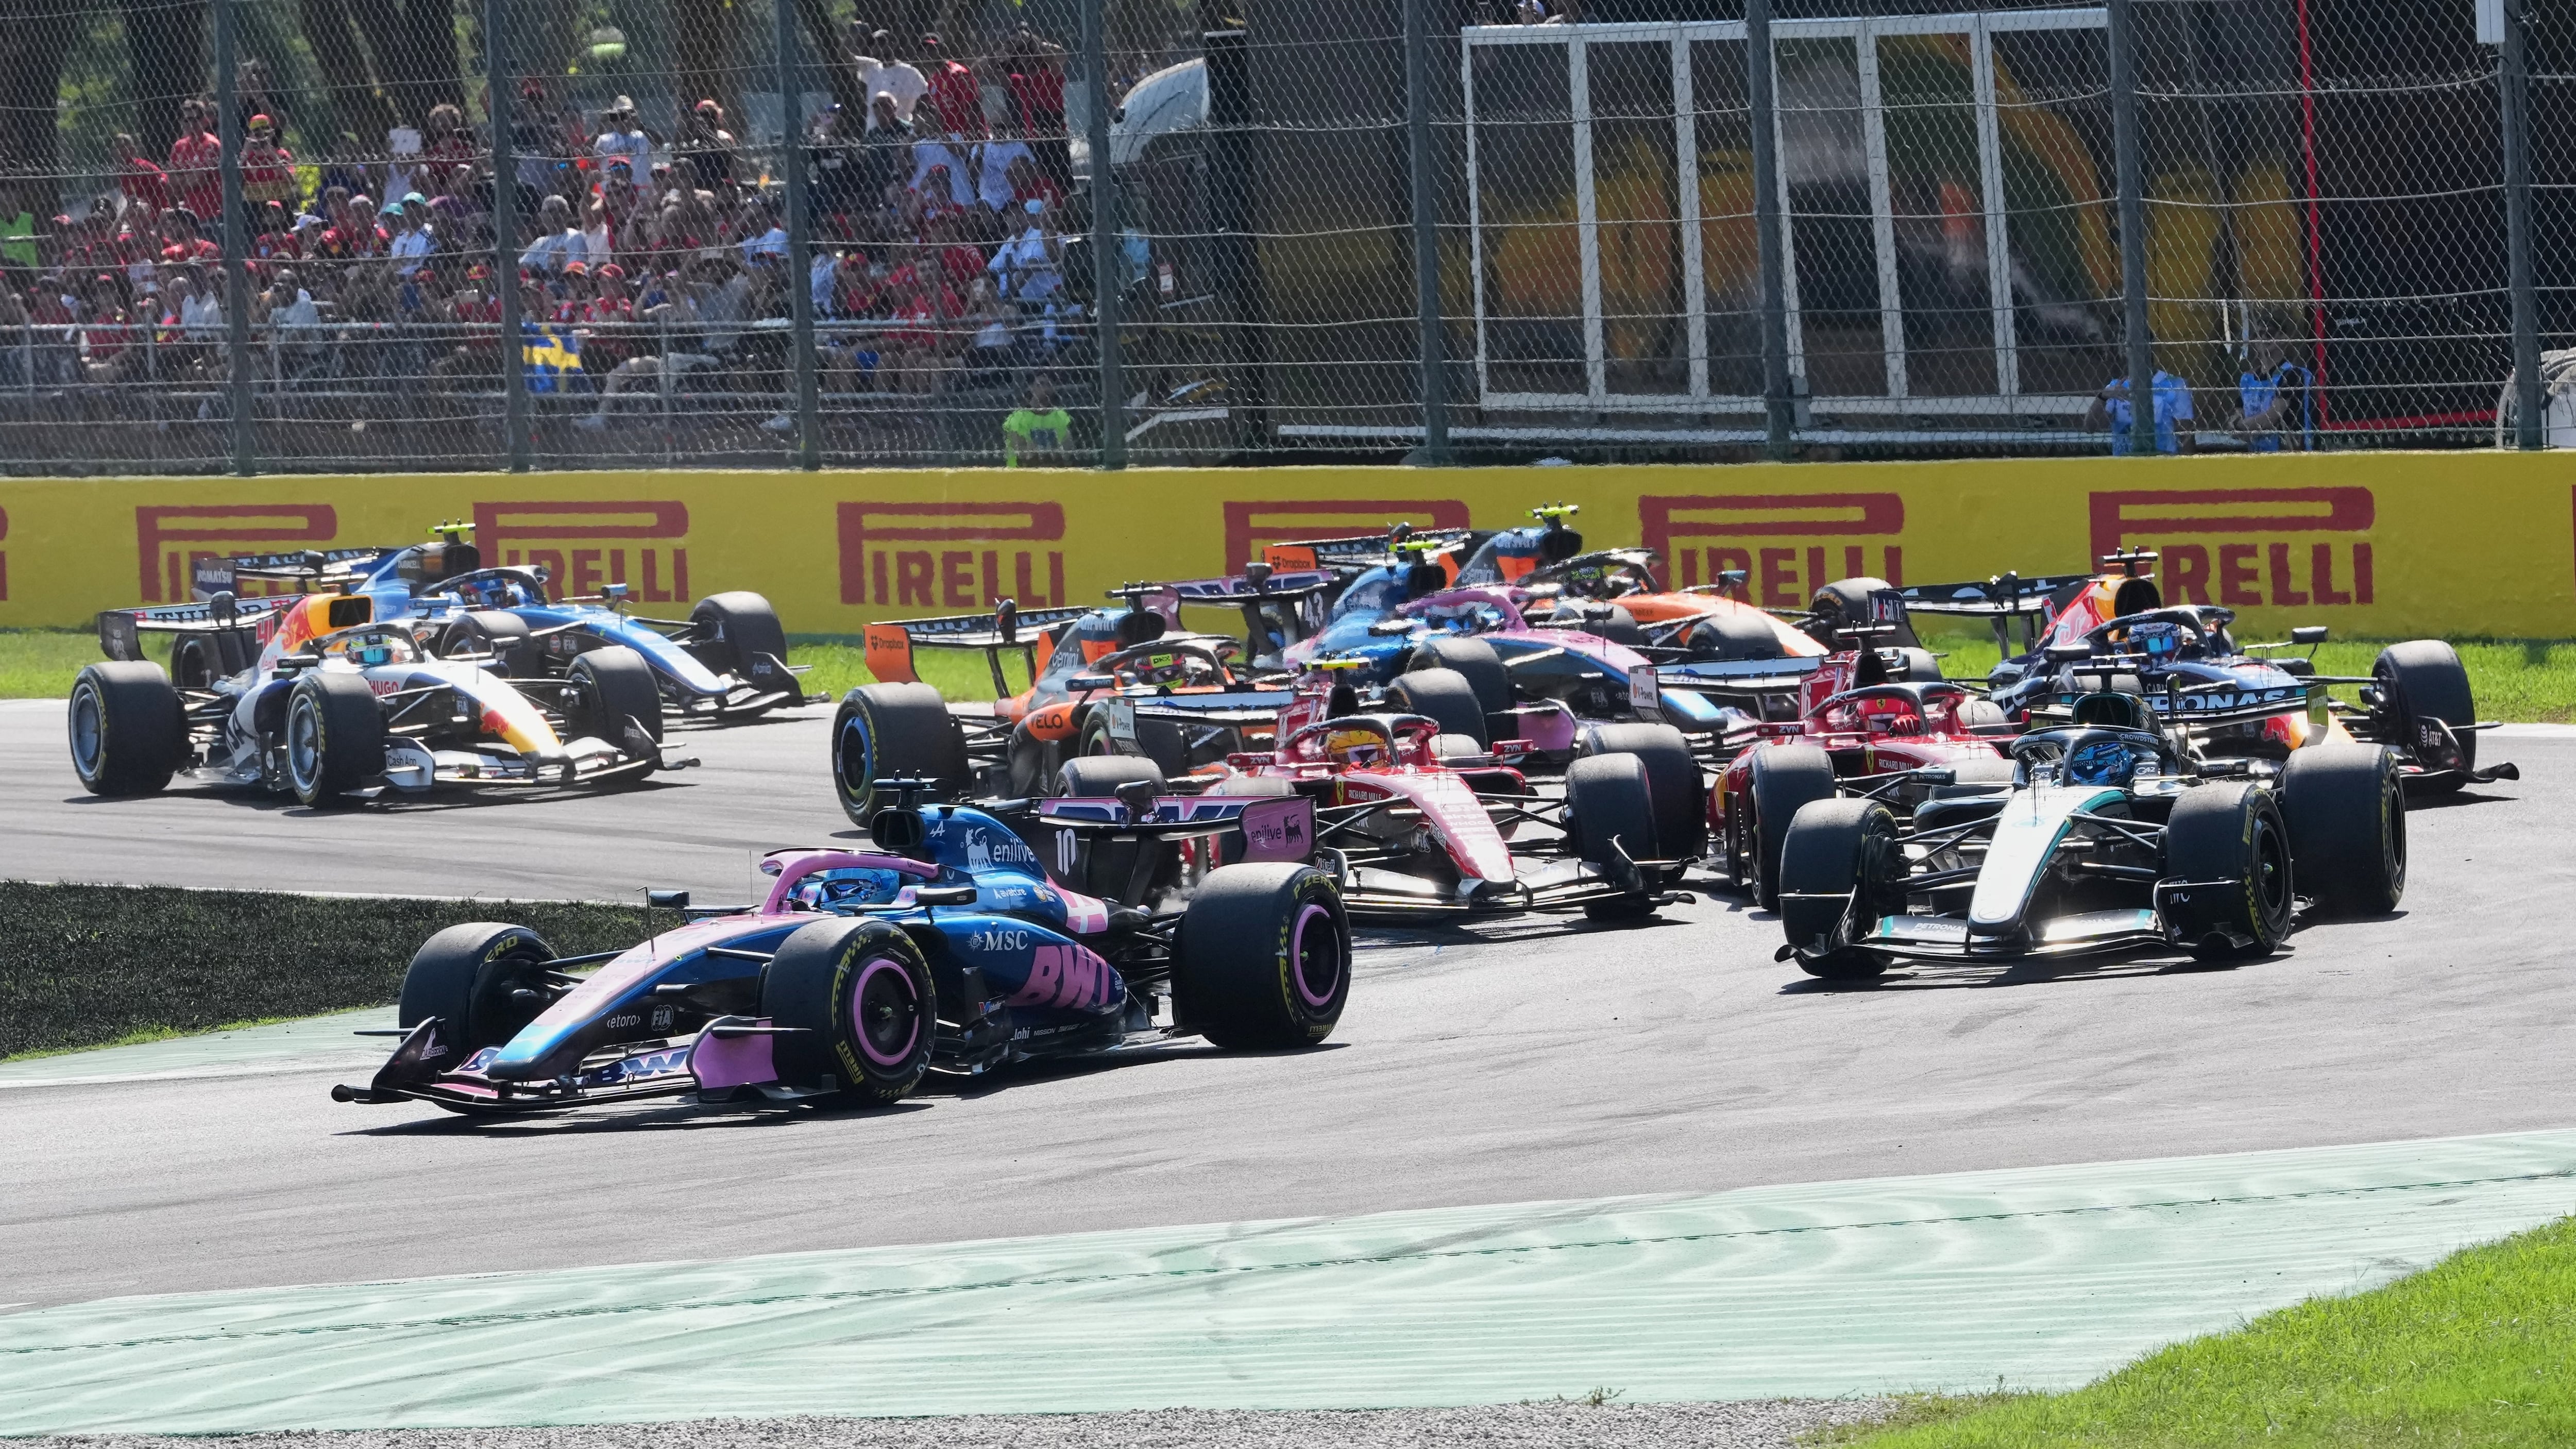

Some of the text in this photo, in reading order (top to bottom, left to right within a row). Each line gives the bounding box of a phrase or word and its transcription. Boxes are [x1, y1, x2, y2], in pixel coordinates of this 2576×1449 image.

[2089, 486, 2375, 605] PRELLI
[837, 501, 1065, 608] PIRELLI
[1283, 558, 1311, 568] Dropbox
[196, 568, 232, 584] KOMATSU
[1872, 597, 1895, 621] Mobil
[879, 637, 905, 651] Dropbox
[1053, 647, 1079, 668] Gemini
[368, 681, 399, 696] HUGO
[1778, 726, 1800, 734] ZYN
[2119, 733, 2159, 746] CROWDSTRIKE
[2428, 731, 2442, 747] AT&T
[1504, 744, 1521, 753] ZYN
[387, 754, 404, 766] Cash
[1878, 759, 1898, 770] RICHARD
[1348, 789, 1368, 800] RICHARD
[1251, 824, 1282, 844] enilive
[993, 838, 1035, 862] enilive
[1056, 828, 1076, 876] 10
[1293, 874, 1336, 899] P ZERO
[1914, 922, 1967, 932] PETRONAS
[983, 930, 1029, 951] MSC
[1006, 943, 1110, 1009] BWT
[1033, 1028, 1056, 1037] MISSION
